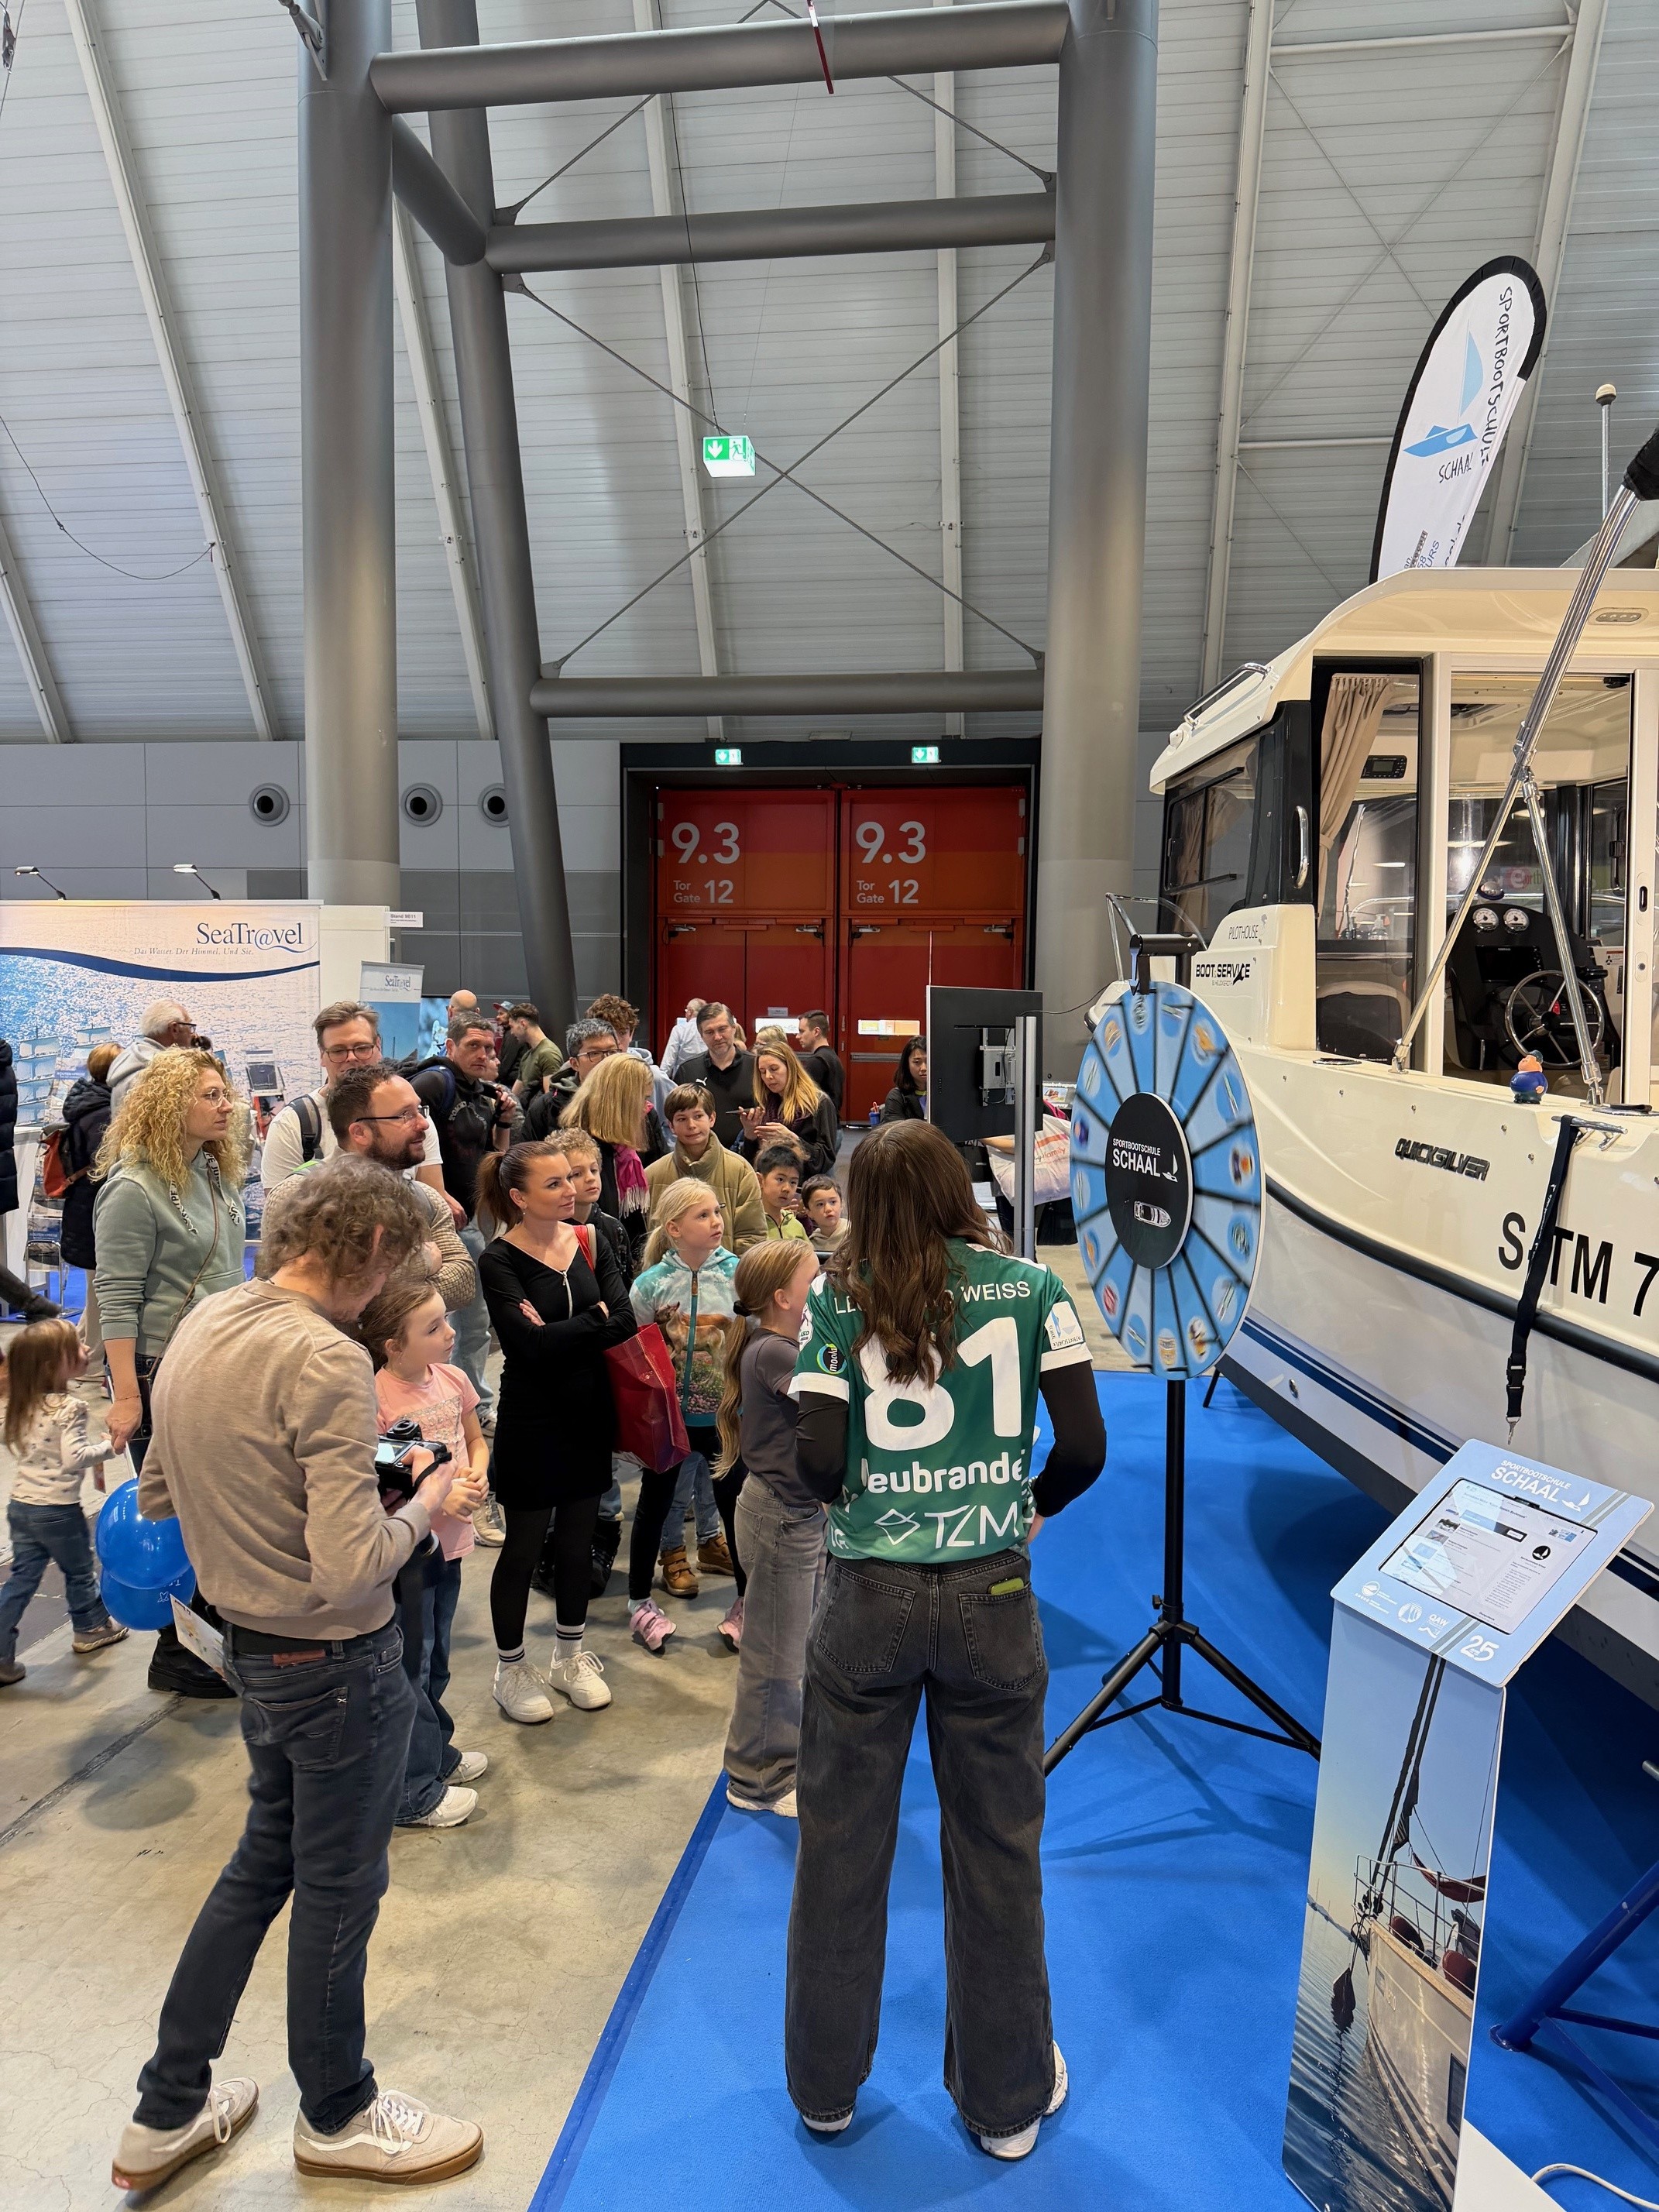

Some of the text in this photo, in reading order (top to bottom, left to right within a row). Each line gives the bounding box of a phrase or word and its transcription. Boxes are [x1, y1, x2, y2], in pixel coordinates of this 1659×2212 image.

[672, 822, 740, 864] 9.3
[856, 821, 926, 864] 9.3
[673, 880, 692, 891] Tor
[704, 880, 734, 904] 12
[857, 880, 875, 891] Tor
[857, 892, 884, 904] Gate
[888, 879, 919, 904] 12
[673, 893, 701, 904] Gate
[1228, 924, 1259, 939] PILOTHOUSE
[1112, 1138, 1161, 1156] SPORTBOOTSCHULE
[1112, 1148, 1161, 1177] SCHAAL
[1395, 1138, 1490, 1182] QUICKSILVER
[960, 1281, 1031, 1303] WEISS
[858, 1317, 1022, 1451] 81
[1491, 1466, 1560, 1503] SCHAAL
[1501, 1460, 1571, 1489] SPORTBOOTSCHULE
[924, 1501, 1019, 1549] TZM
[1429, 1613, 1449, 1626] QAW
[1460, 1635, 1499, 1661] 25
